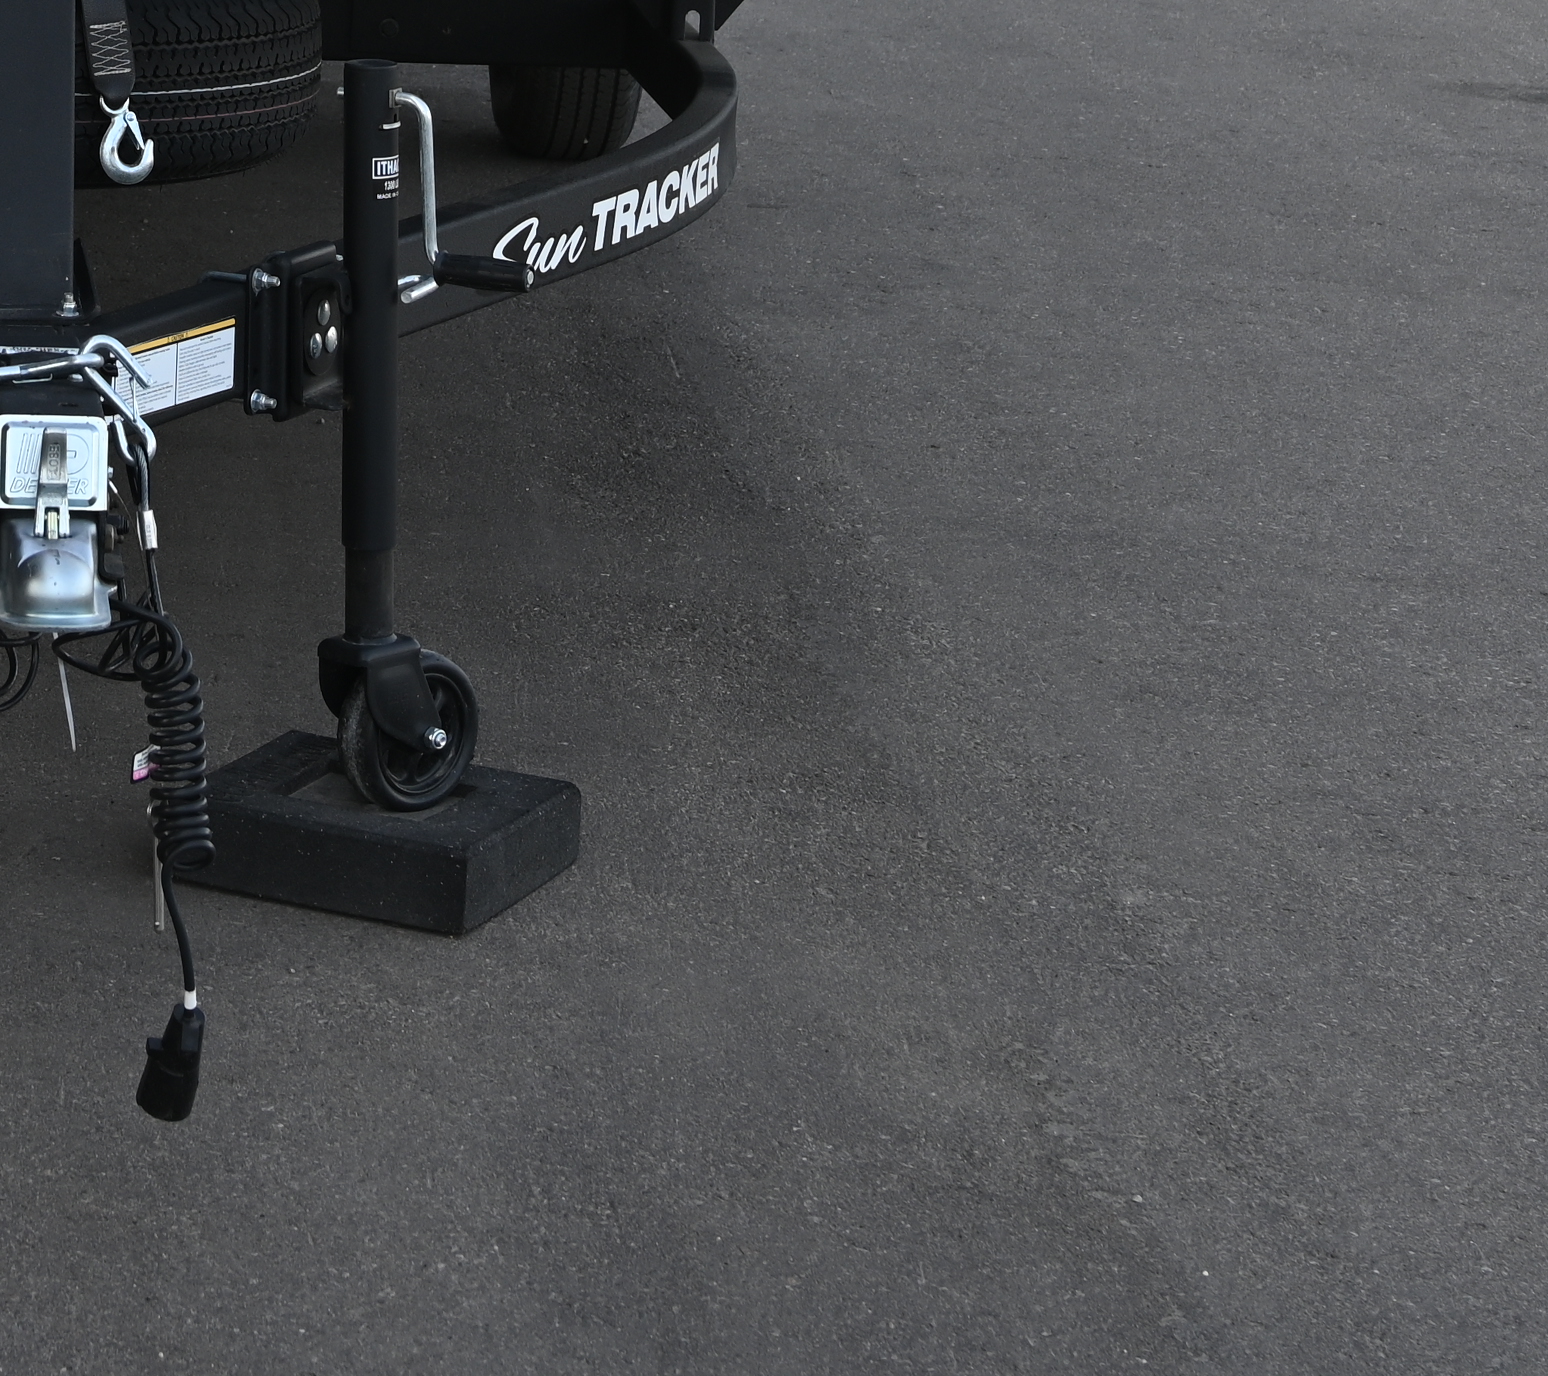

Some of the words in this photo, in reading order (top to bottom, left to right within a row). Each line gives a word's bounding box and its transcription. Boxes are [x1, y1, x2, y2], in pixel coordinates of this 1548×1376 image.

[493, 216, 587, 274] Sun
[592, 142, 720, 252] TRACKER
[10, 476, 88, 495] DEER
